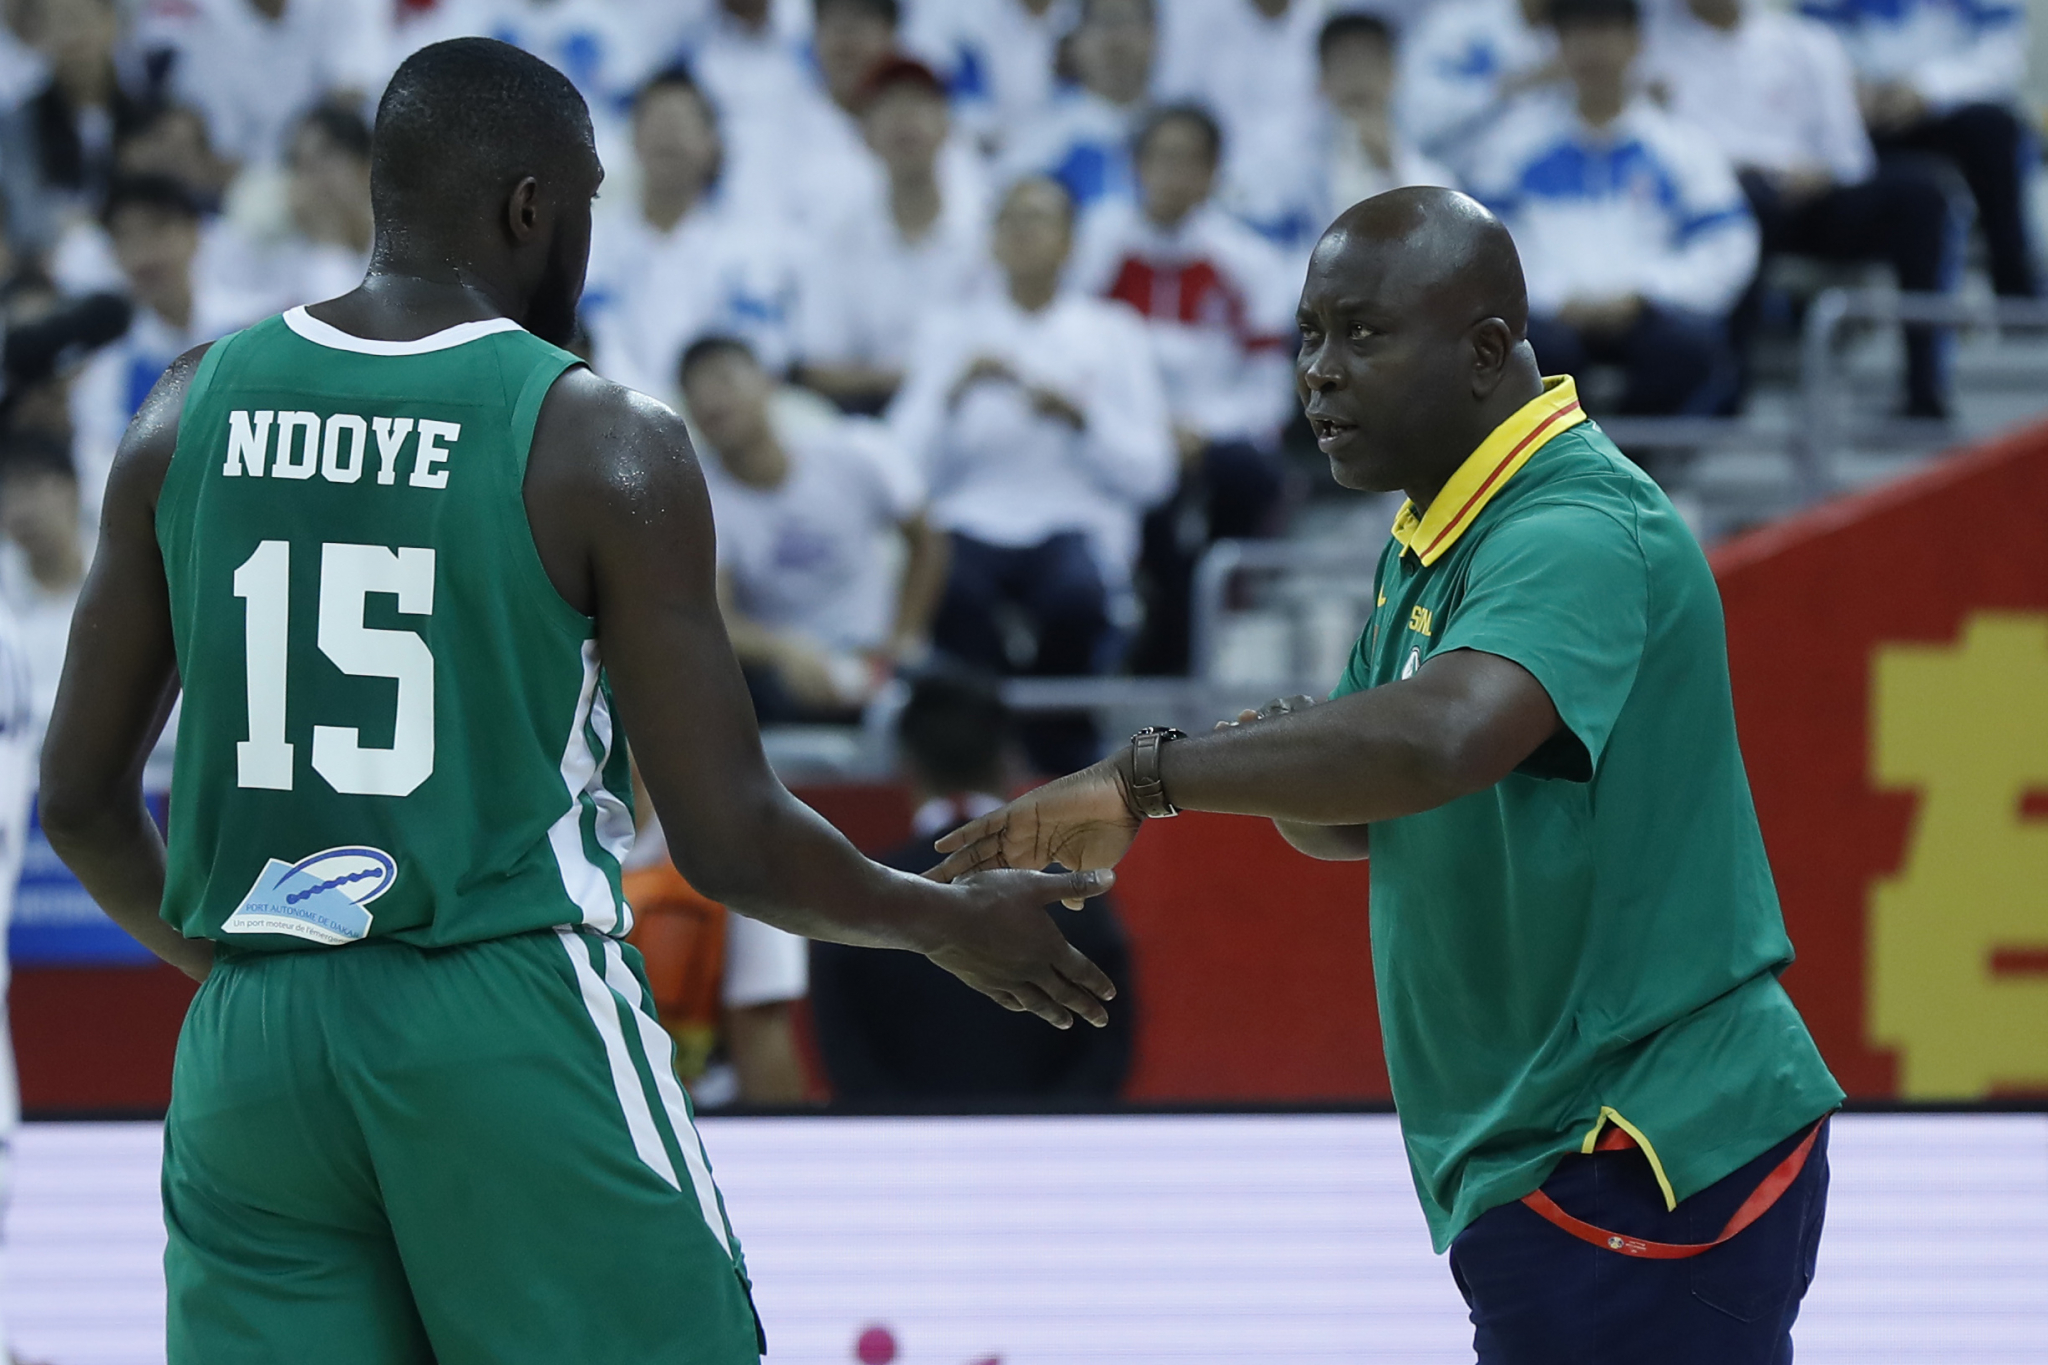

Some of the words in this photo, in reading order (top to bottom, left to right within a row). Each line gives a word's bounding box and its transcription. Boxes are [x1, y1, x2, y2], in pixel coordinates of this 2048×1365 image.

[222, 410, 461, 490] NDOYE
[233, 539, 436, 798] 15
[233, 919, 245, 927] Un
[246, 919, 264, 928] port
[265, 920, 293, 930] moteur
[295, 923, 305, 932] de
[246, 904, 269, 912] PORT
[270, 905, 316, 920] AUTONOME
[318, 915, 330, 926] DE
